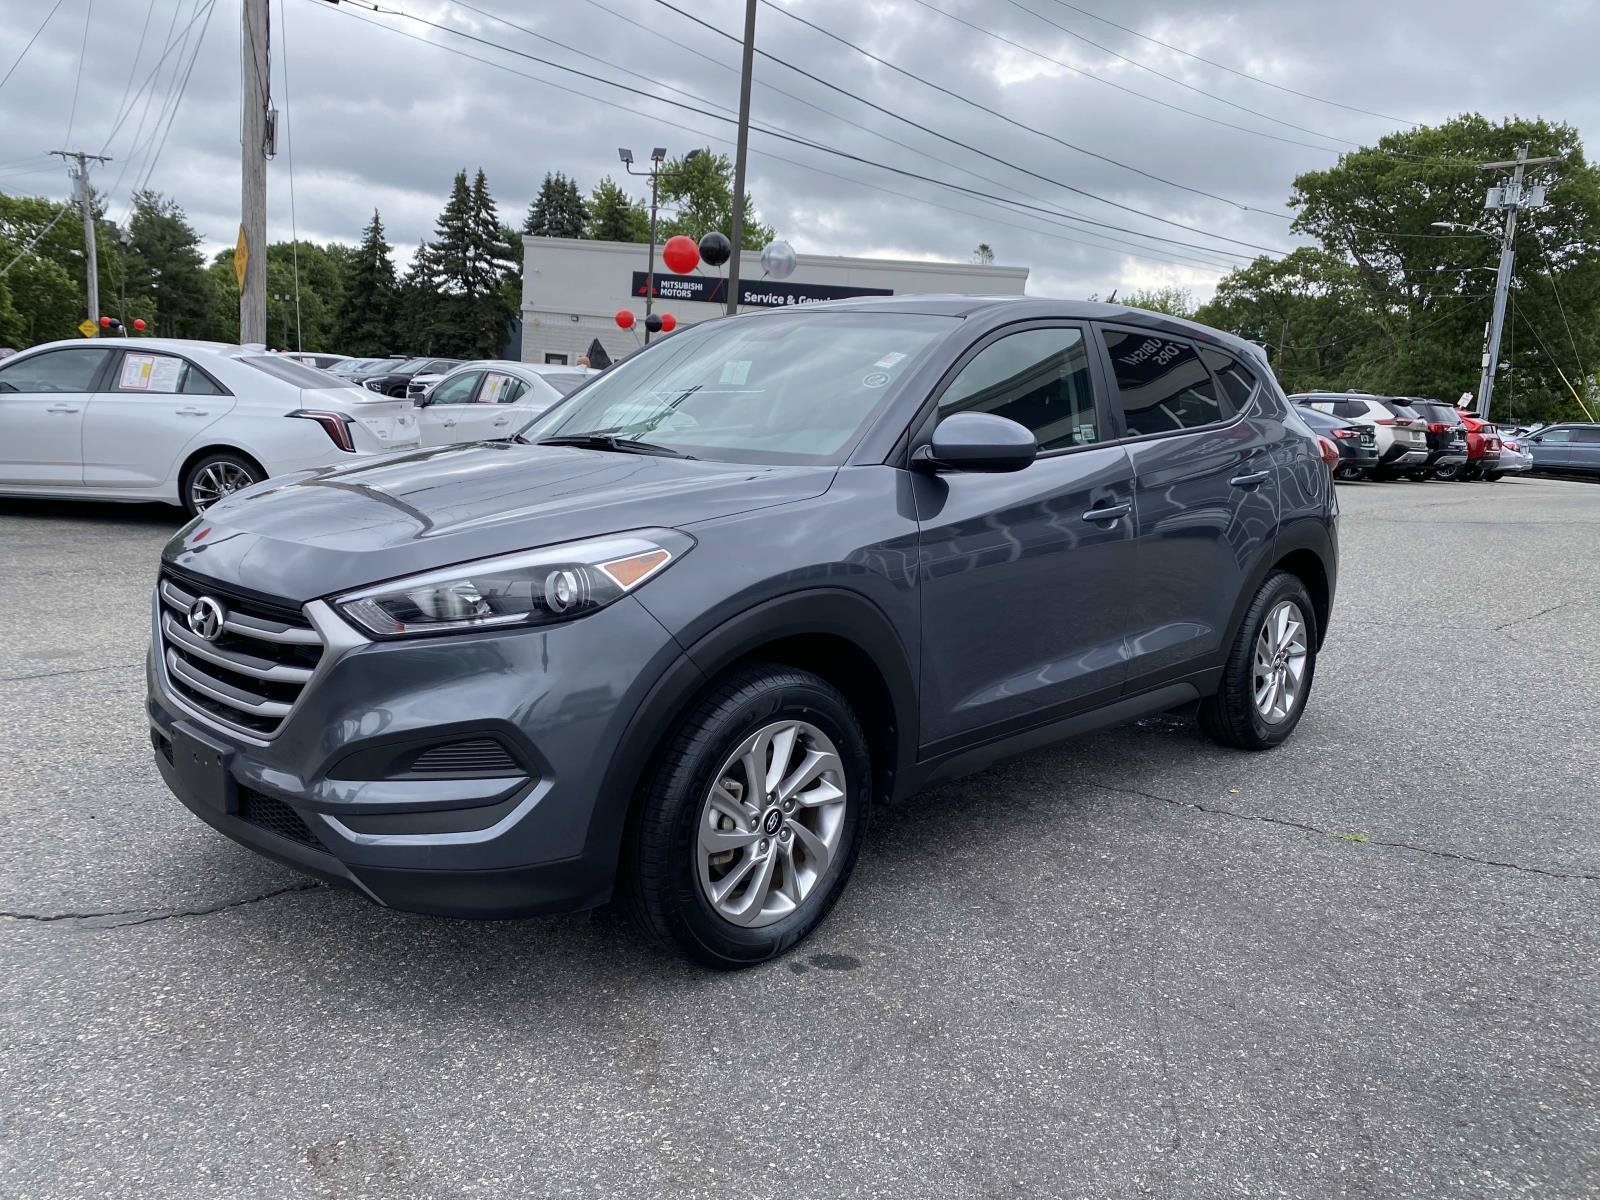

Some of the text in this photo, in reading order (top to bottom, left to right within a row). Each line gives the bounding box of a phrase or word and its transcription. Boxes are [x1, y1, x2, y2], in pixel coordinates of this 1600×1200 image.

[660, 280, 703, 291] MITSUBISHI
[660, 288, 692, 298] MOTORS
[744, 291, 785, 305] Service
[786, 294, 796, 305] &
